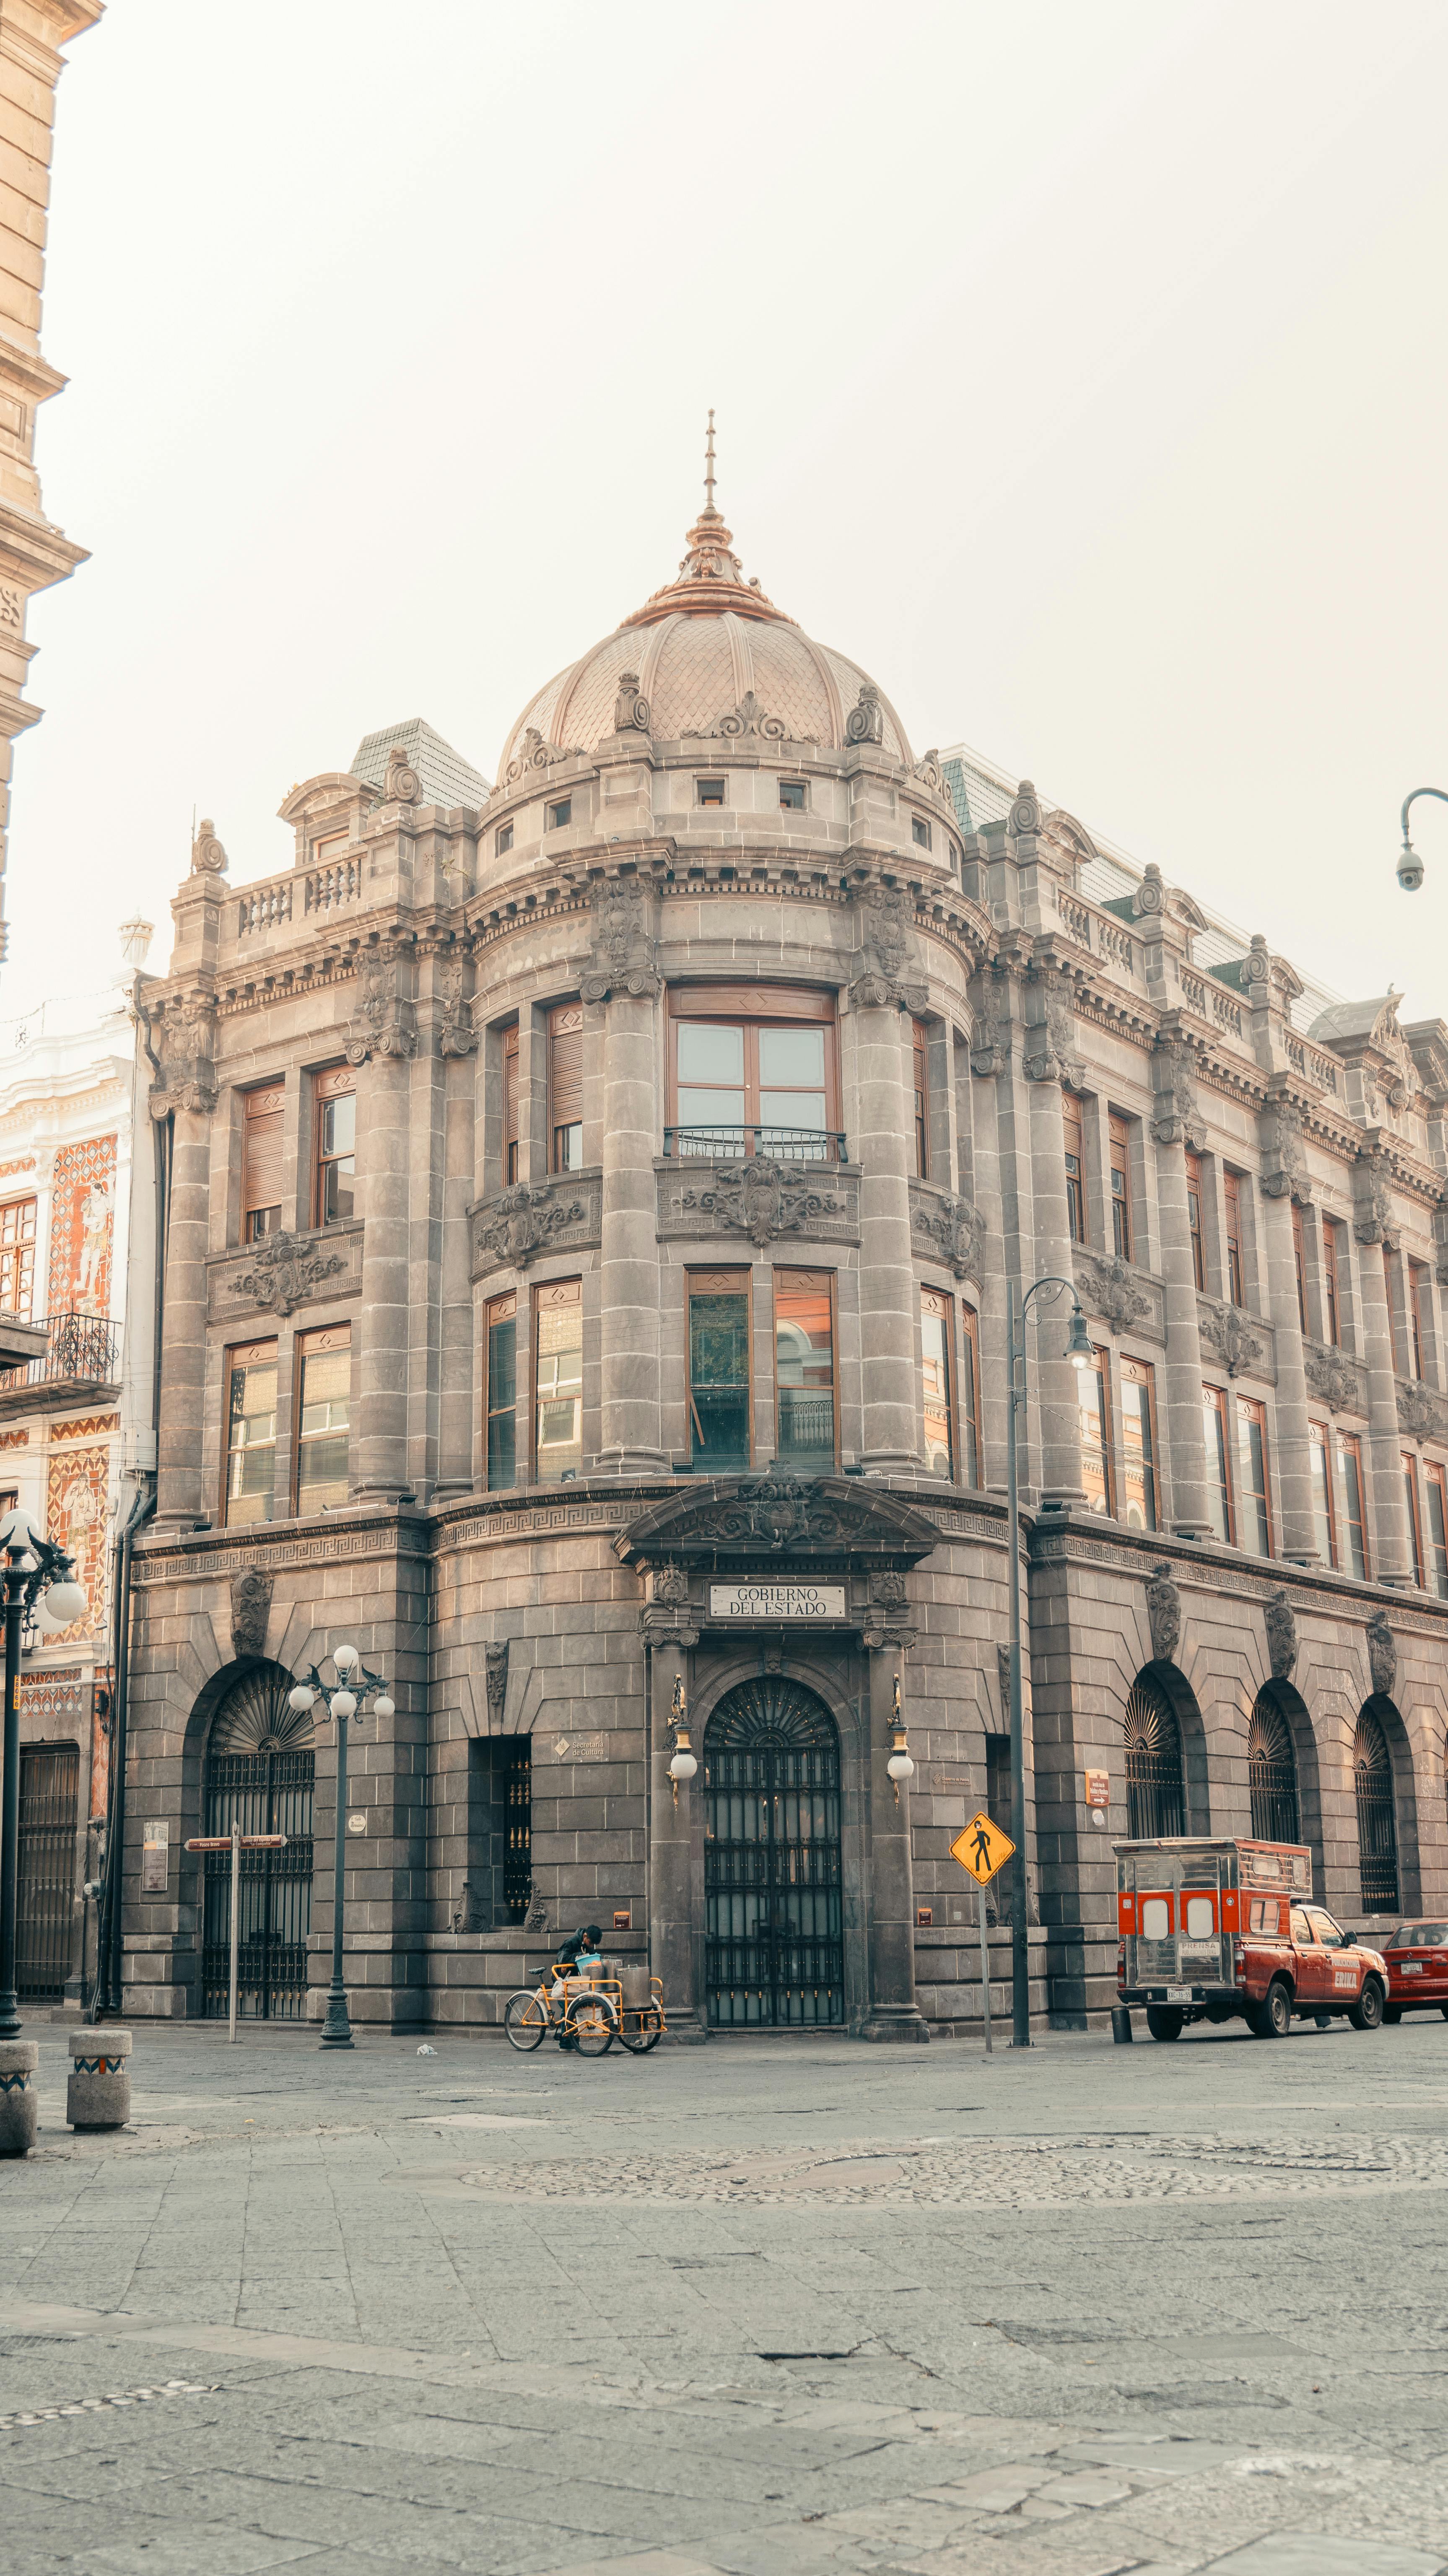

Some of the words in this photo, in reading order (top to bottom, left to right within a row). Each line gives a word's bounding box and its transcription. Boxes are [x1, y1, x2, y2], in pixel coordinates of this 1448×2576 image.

[738, 1588, 818, 1601] GOBIERNO
[730, 1602, 760, 1615] DEL
[765, 1602, 826, 1615] ESTADO
[1334, 1971, 1357, 1989] ERIKA
